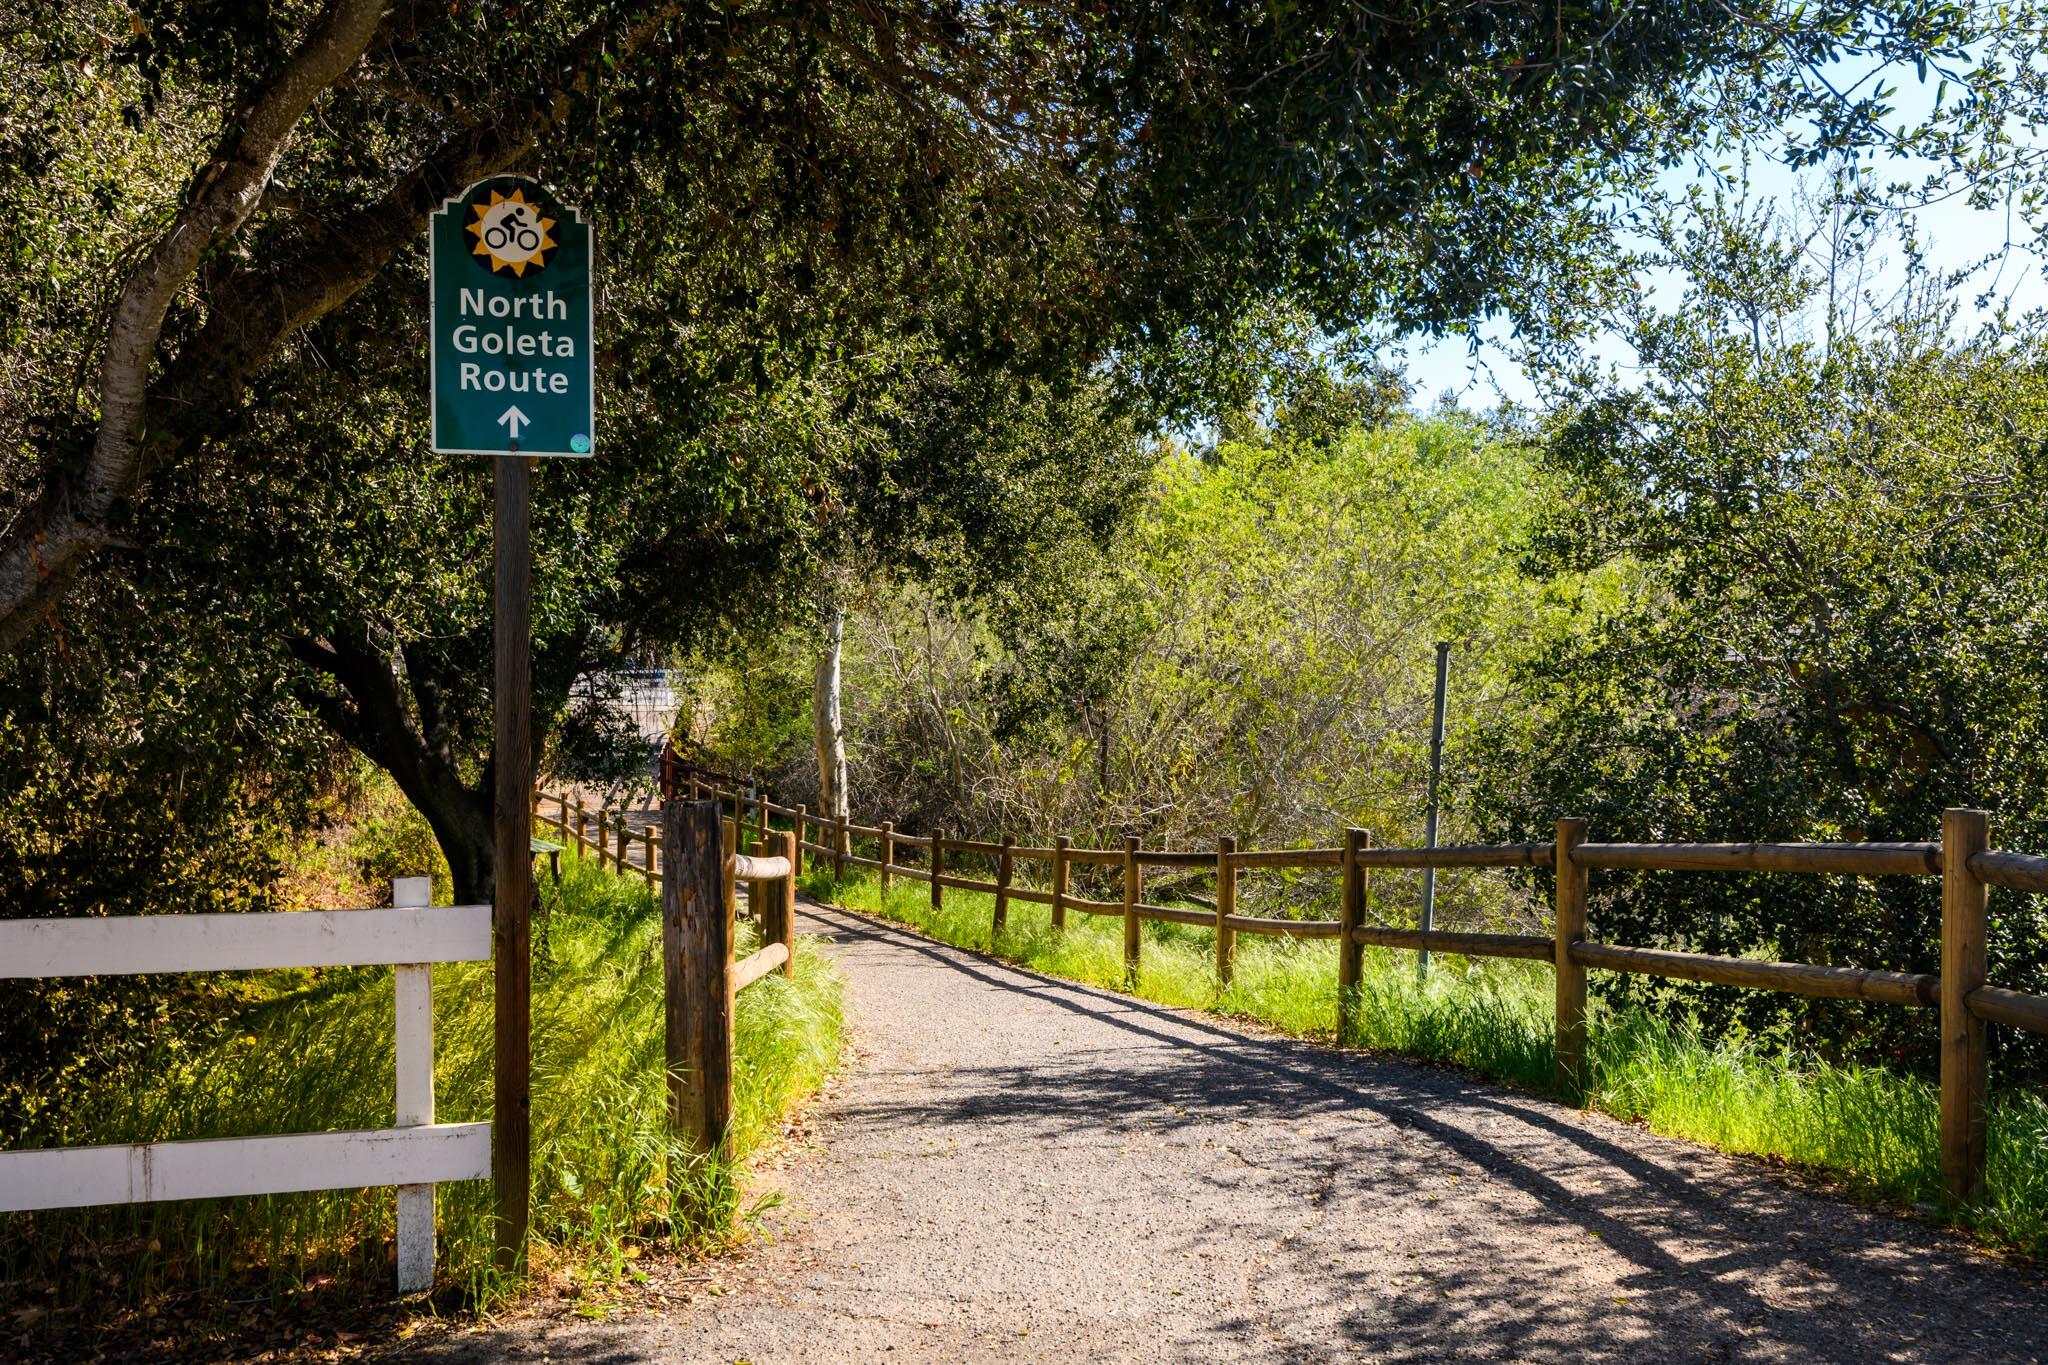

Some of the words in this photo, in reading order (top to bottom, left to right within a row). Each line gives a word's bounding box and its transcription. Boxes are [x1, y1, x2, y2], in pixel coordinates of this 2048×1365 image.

[460, 288, 567, 320] North
[453, 325, 575, 357] Goleta
[460, 363, 569, 394] Route
